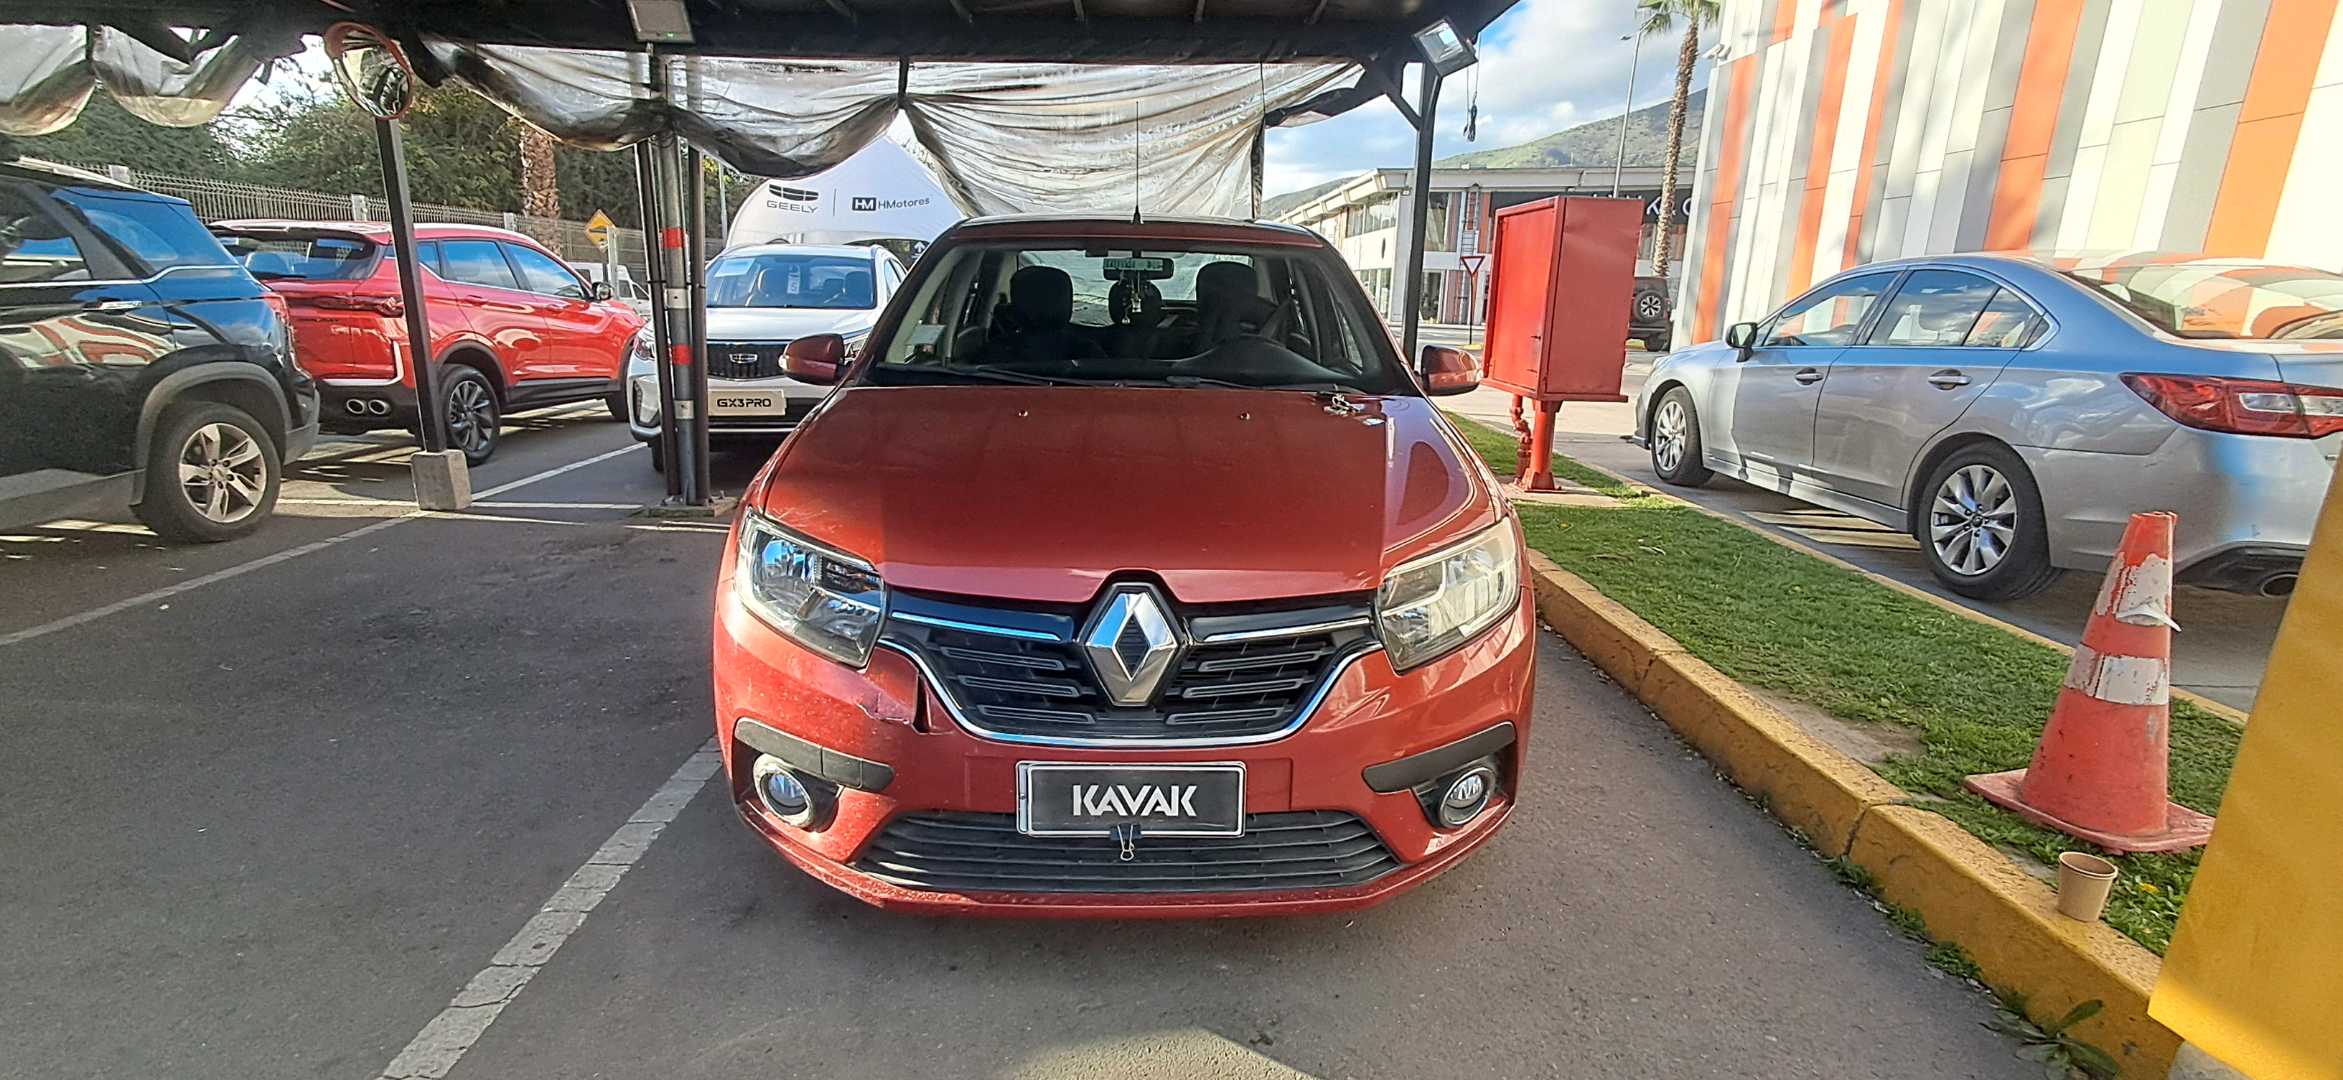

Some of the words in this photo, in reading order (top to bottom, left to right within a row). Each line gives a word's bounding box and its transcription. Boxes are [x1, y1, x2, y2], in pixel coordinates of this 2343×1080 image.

[767, 200, 818, 213] GEELY
[855, 199, 875, 210] HM
[878, 198, 930, 210] HMotores
[1072, 785, 1198, 817] KAVAK
